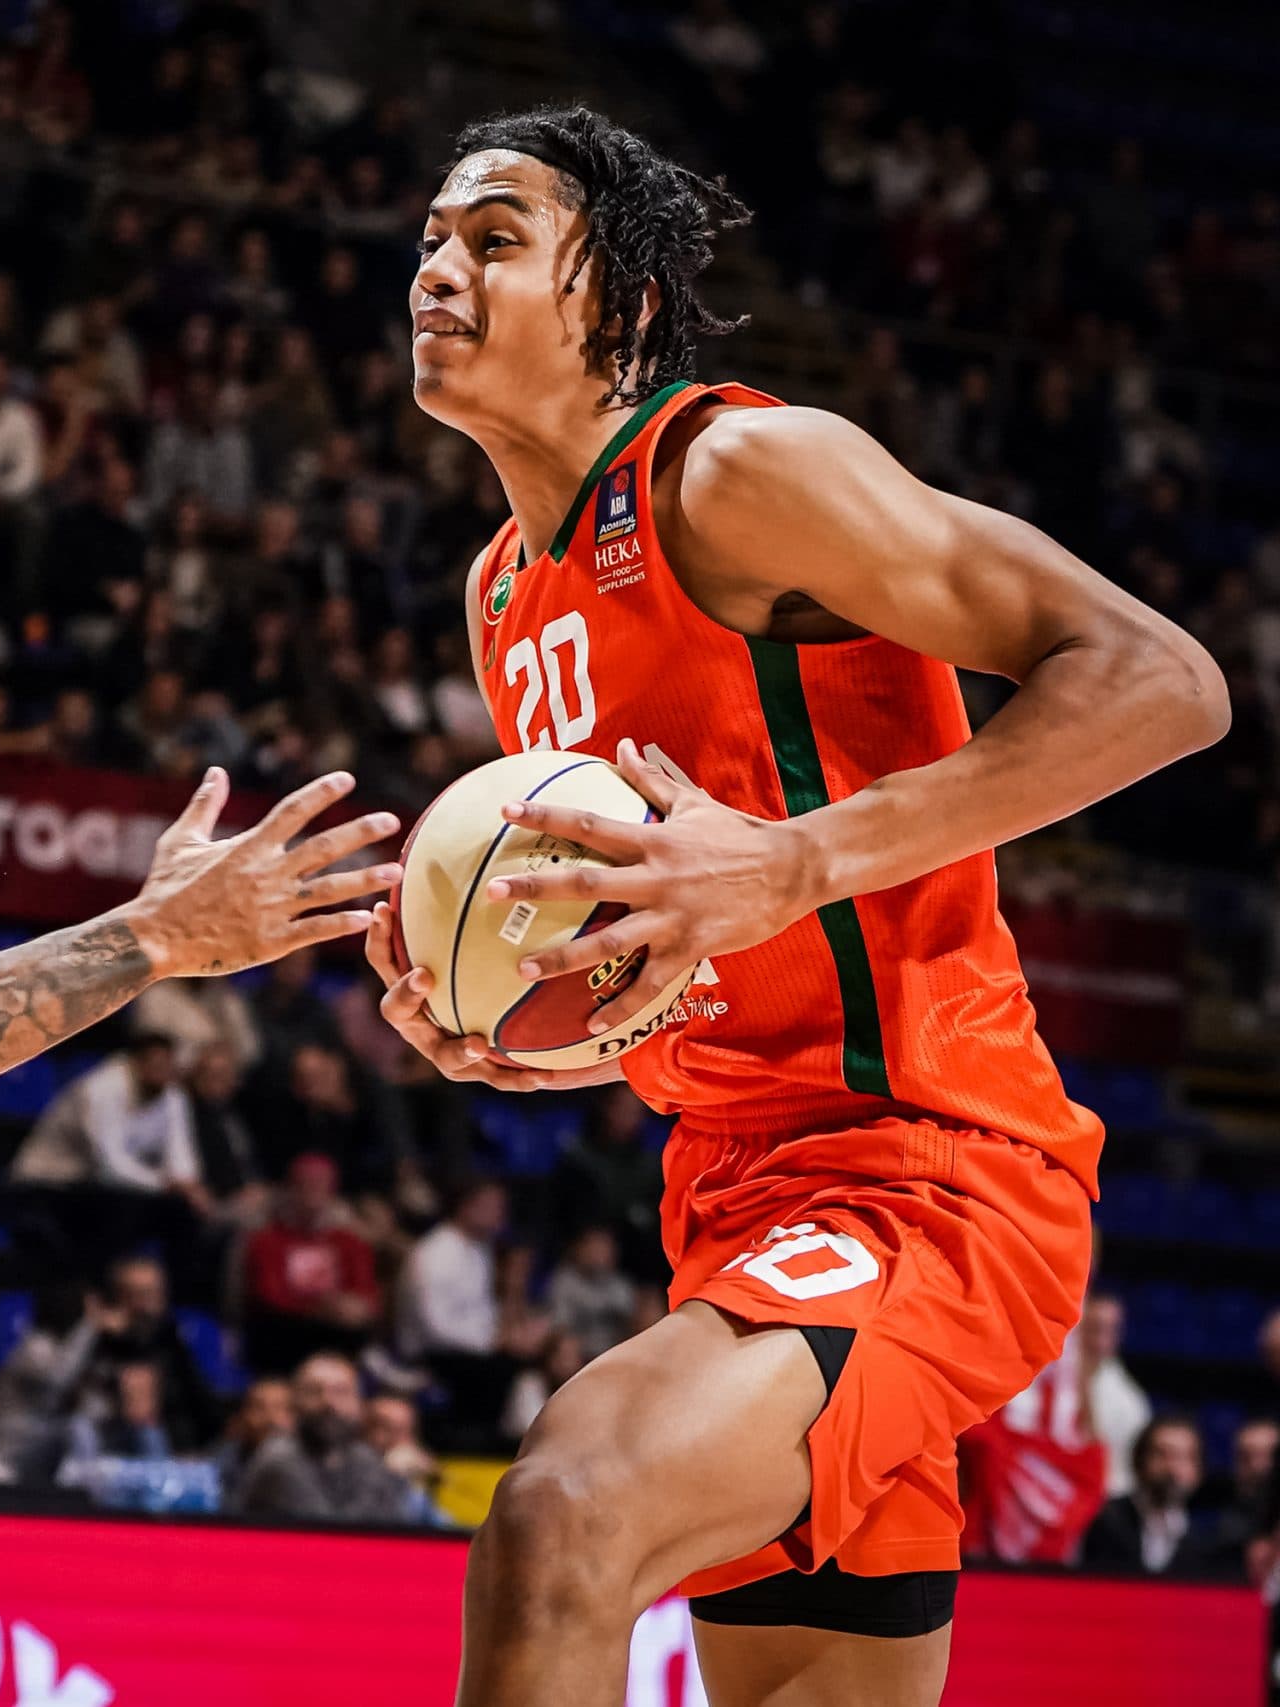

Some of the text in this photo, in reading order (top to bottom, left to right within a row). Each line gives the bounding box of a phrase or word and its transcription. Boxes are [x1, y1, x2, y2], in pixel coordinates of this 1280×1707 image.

[610, 494, 627, 517] ABA
[595, 537, 642, 570] HEKA
[596, 571, 646, 595] SUPPLEMENTS
[504, 610, 597, 753] 20
